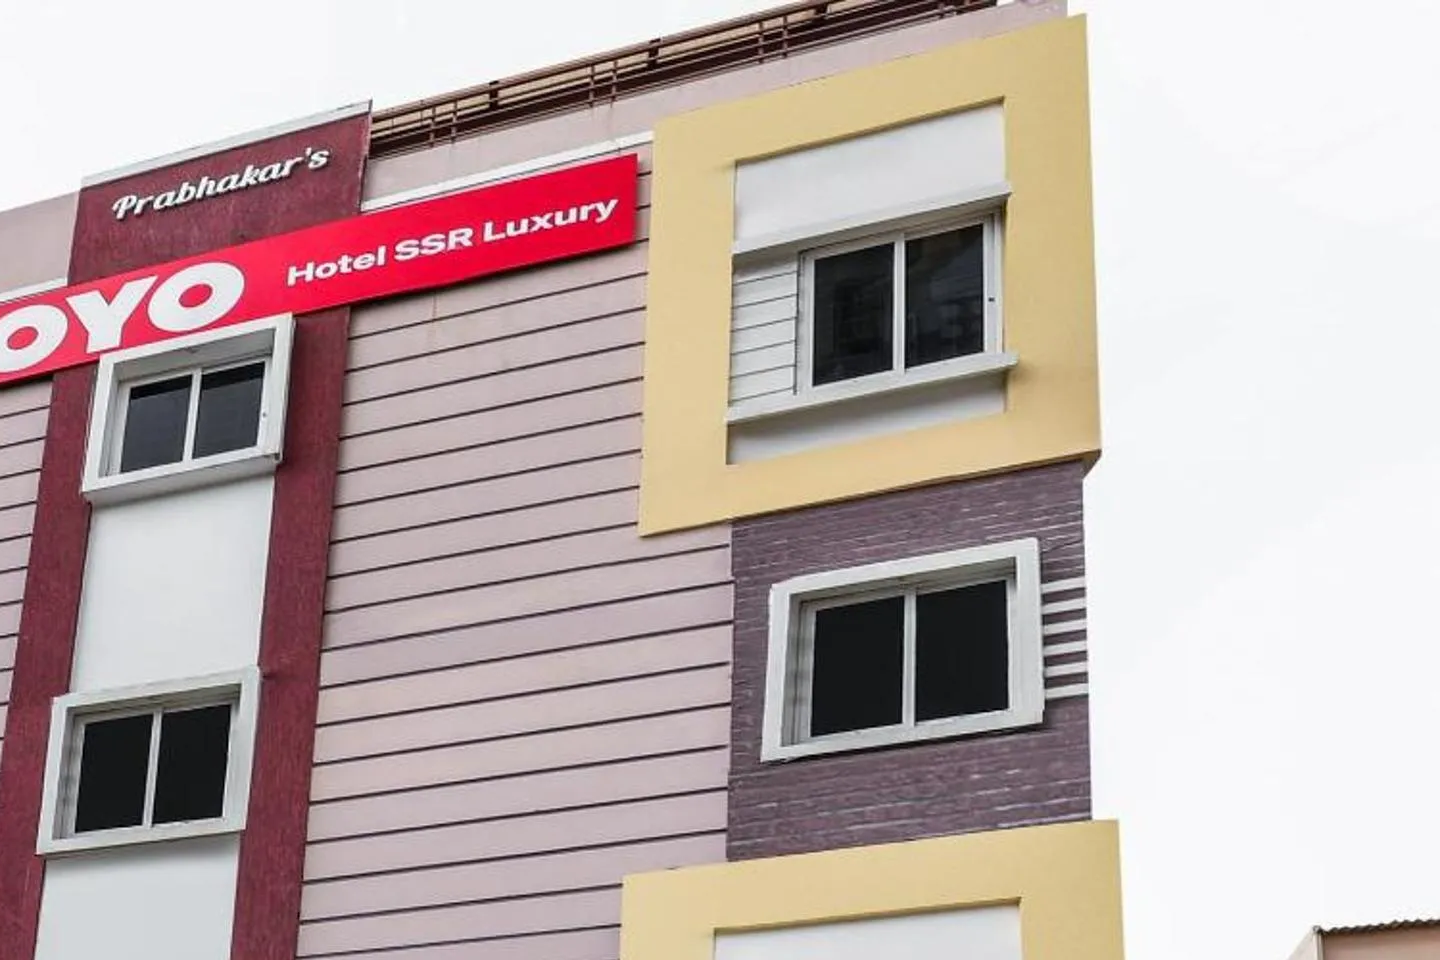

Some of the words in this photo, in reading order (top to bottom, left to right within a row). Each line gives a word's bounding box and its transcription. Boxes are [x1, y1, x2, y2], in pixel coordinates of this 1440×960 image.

[112, 147, 330, 220] Prabhakar's
[287, 245, 387, 287] Hotel
[394, 227, 473, 261] SSR
[483, 198, 619, 243] Luxury
